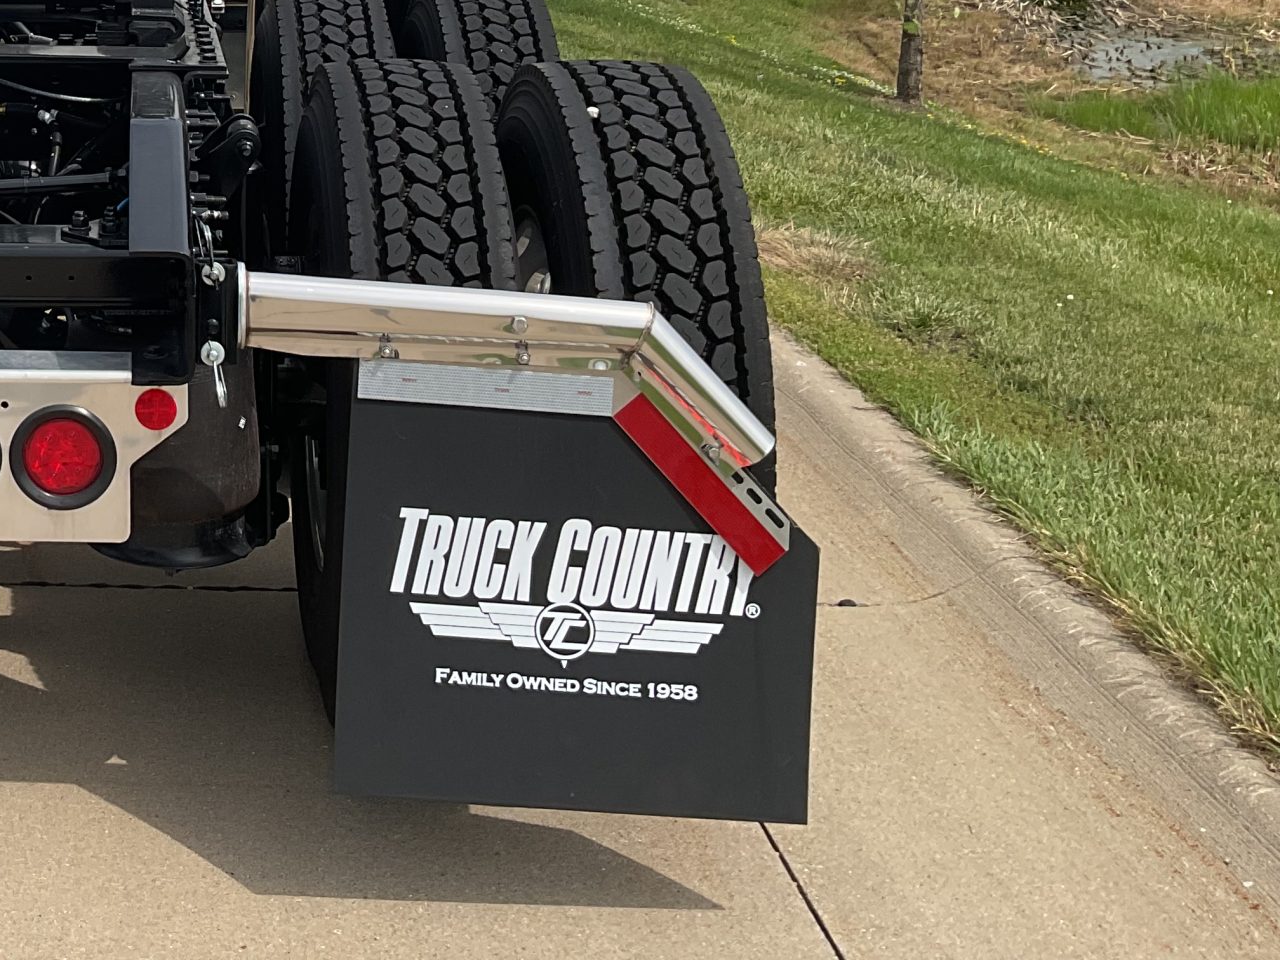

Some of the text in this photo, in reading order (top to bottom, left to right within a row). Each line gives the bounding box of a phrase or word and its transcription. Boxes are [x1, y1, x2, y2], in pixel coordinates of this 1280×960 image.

[390, 507, 547, 602] TRUCK
[435, 667, 698, 701] FAMILY OWNED SINCE 1958
